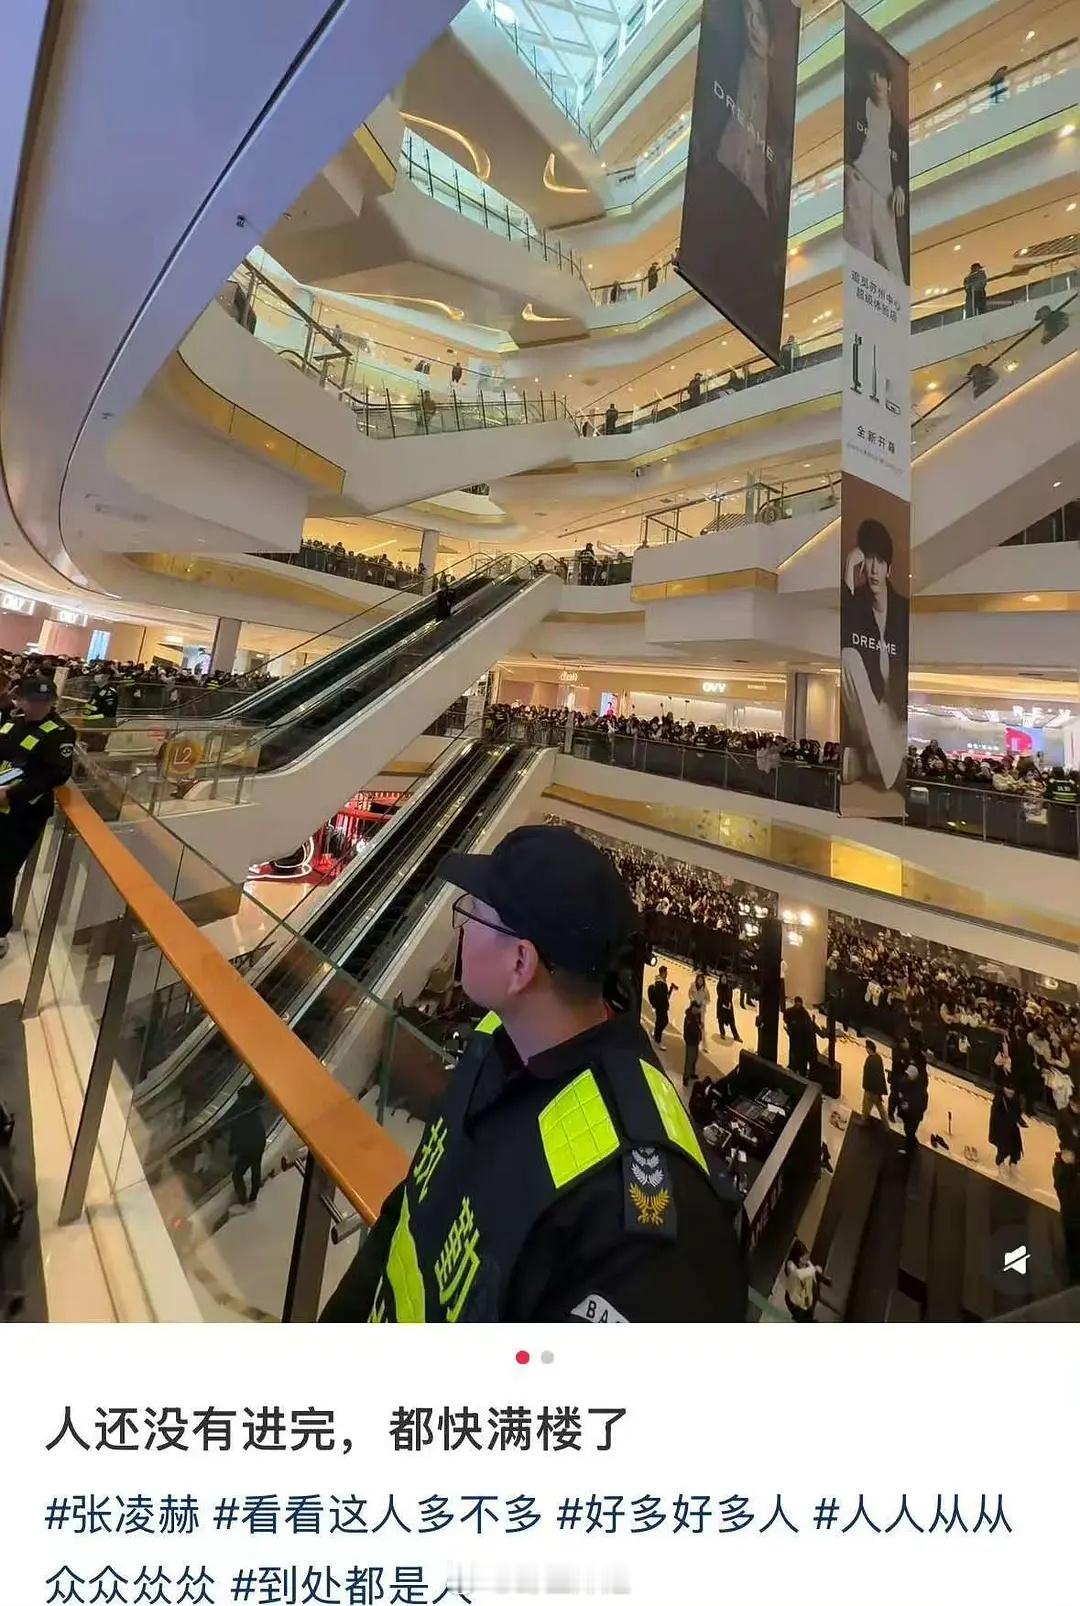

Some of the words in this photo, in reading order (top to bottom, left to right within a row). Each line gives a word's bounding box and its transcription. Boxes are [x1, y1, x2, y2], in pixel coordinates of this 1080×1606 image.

[852, 632, 897, 656] DREAME
[173, 746, 193, 766] L2
[586, 1300, 620, 1323] BA
